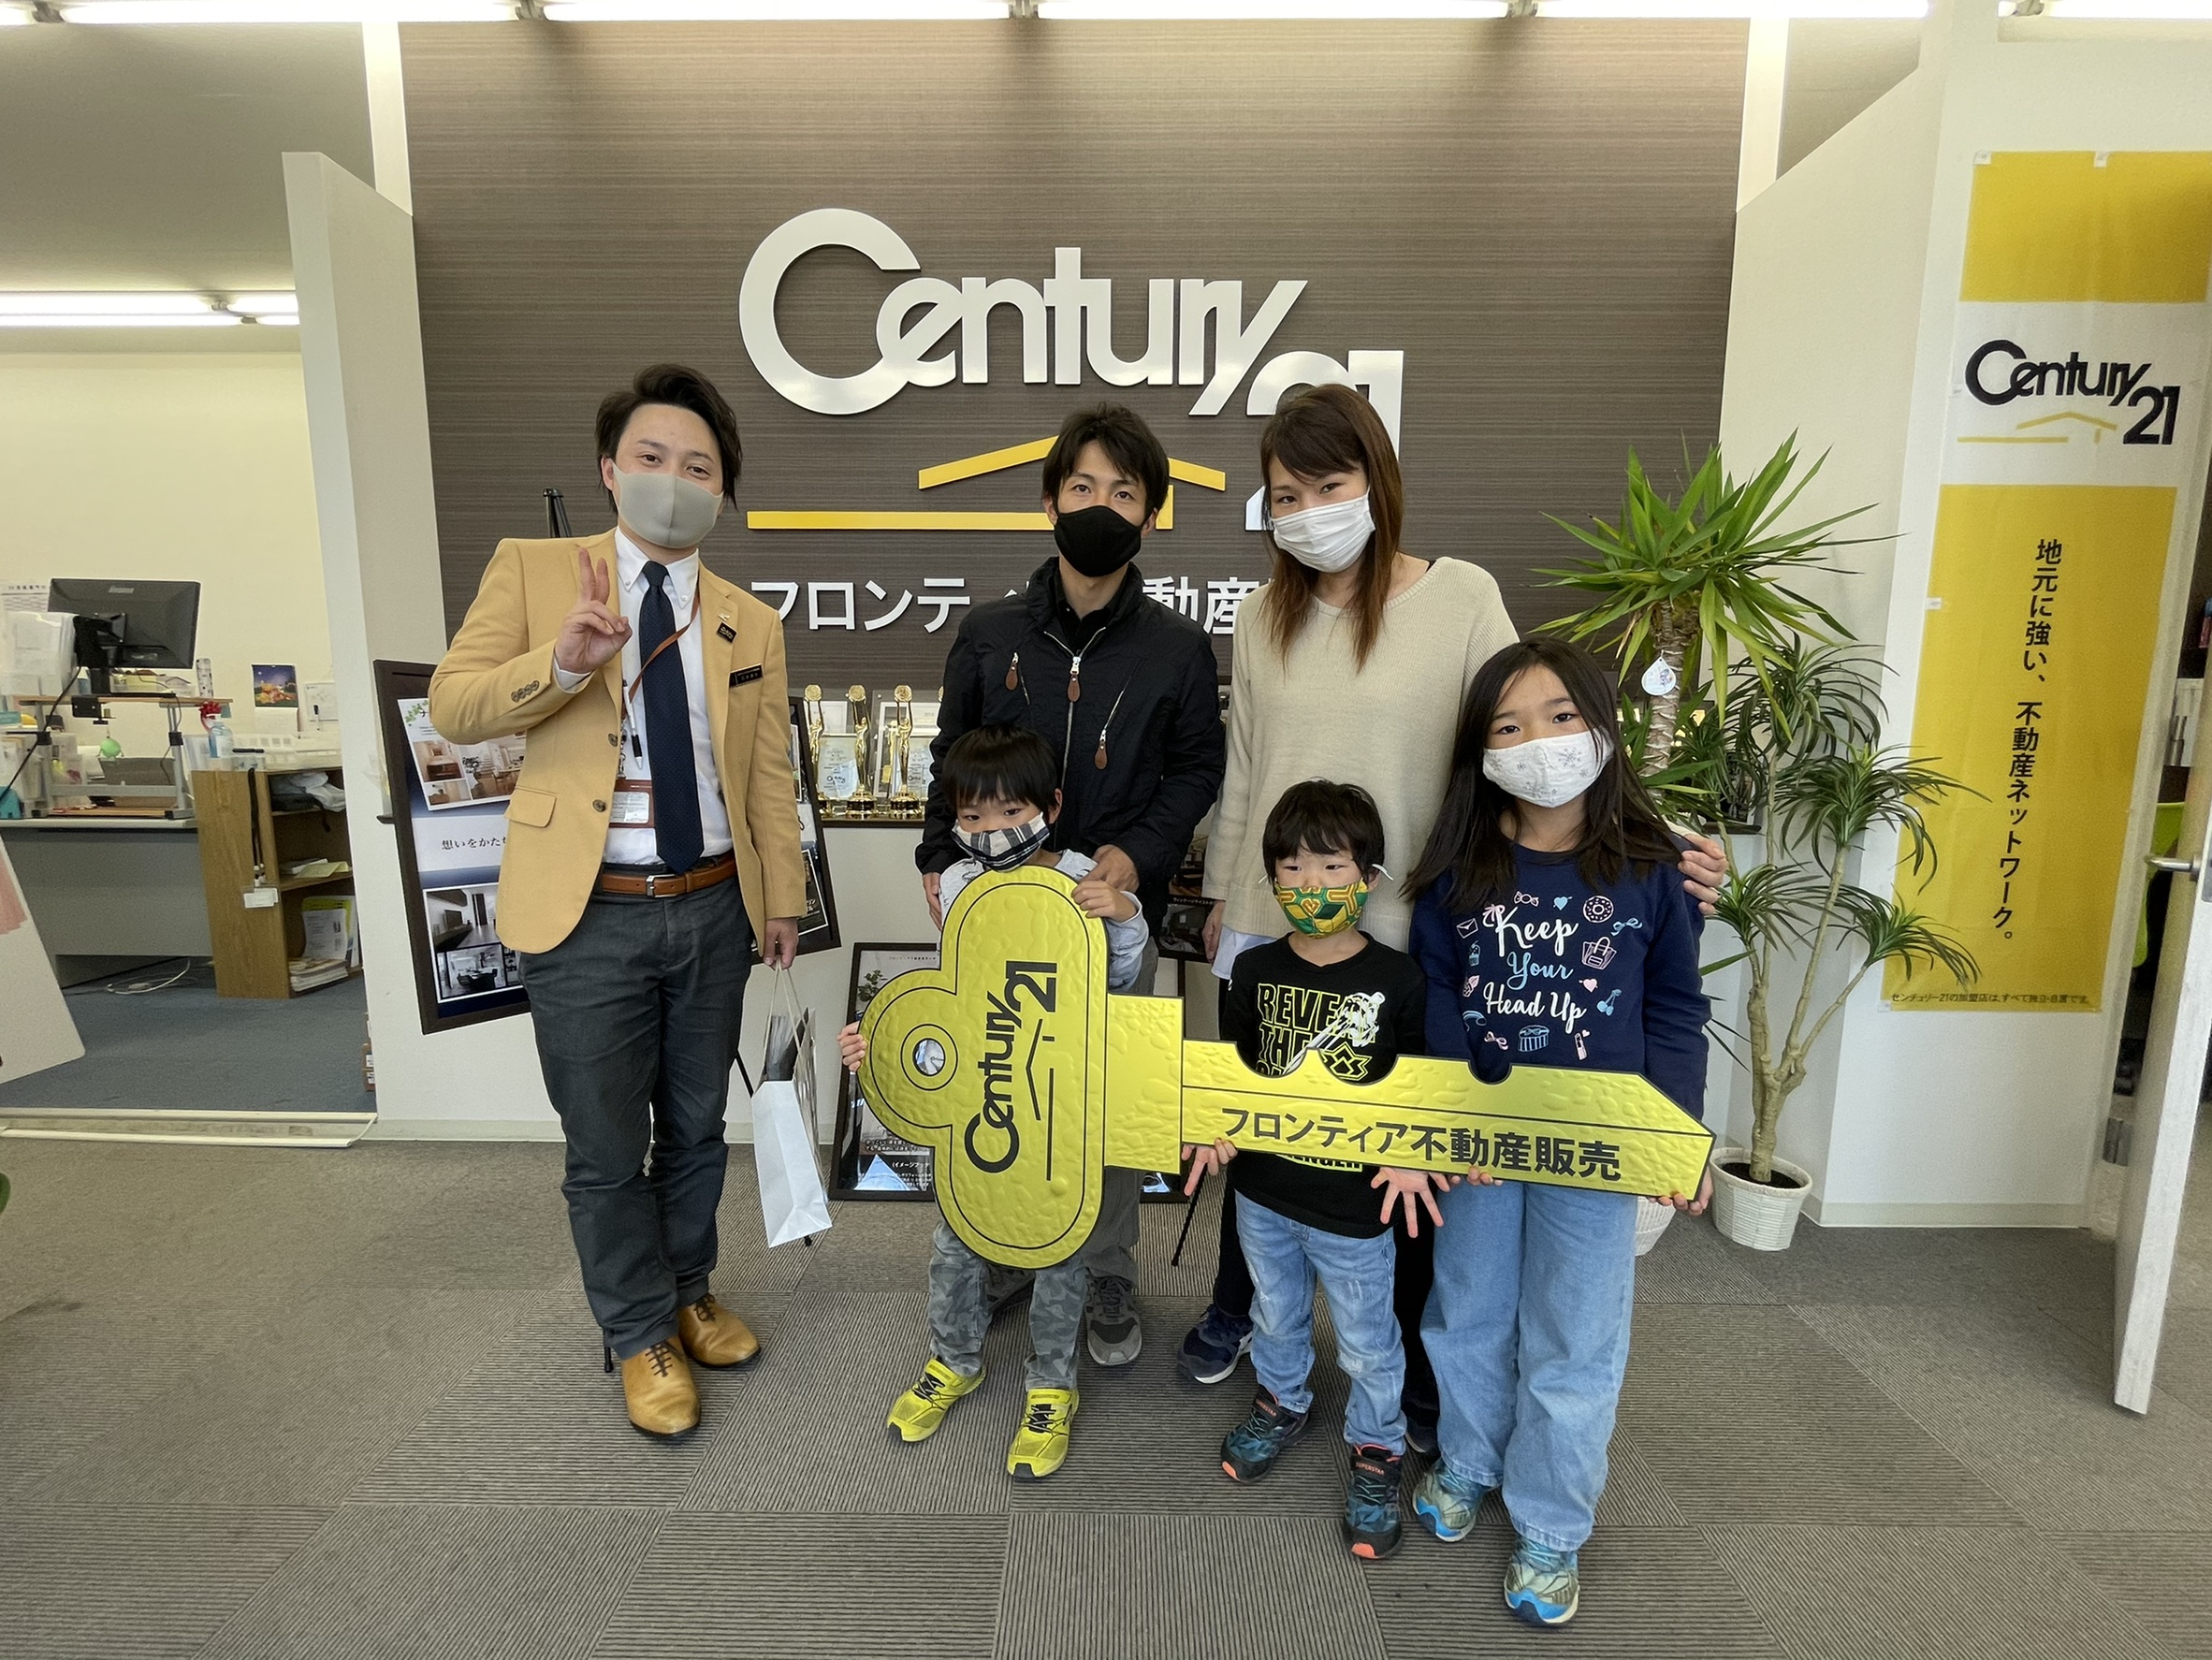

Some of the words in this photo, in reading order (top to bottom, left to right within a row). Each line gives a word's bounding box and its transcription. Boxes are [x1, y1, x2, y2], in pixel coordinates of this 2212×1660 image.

[739, 208, 1308, 415] Century
[1965, 339, 2152, 406] Century
[2122, 386, 2181, 445] 21
[1493, 906, 1579, 957] Keep
[1483, 982, 1545, 1027] Head
[1550, 992, 1587, 1034] Up
[1506, 951, 1574, 991] Your
[964, 990, 1022, 1174] Century
[1004, 960, 1057, 1013] 21
[1222, 1107, 1621, 1182] フロンティア不動産販売
